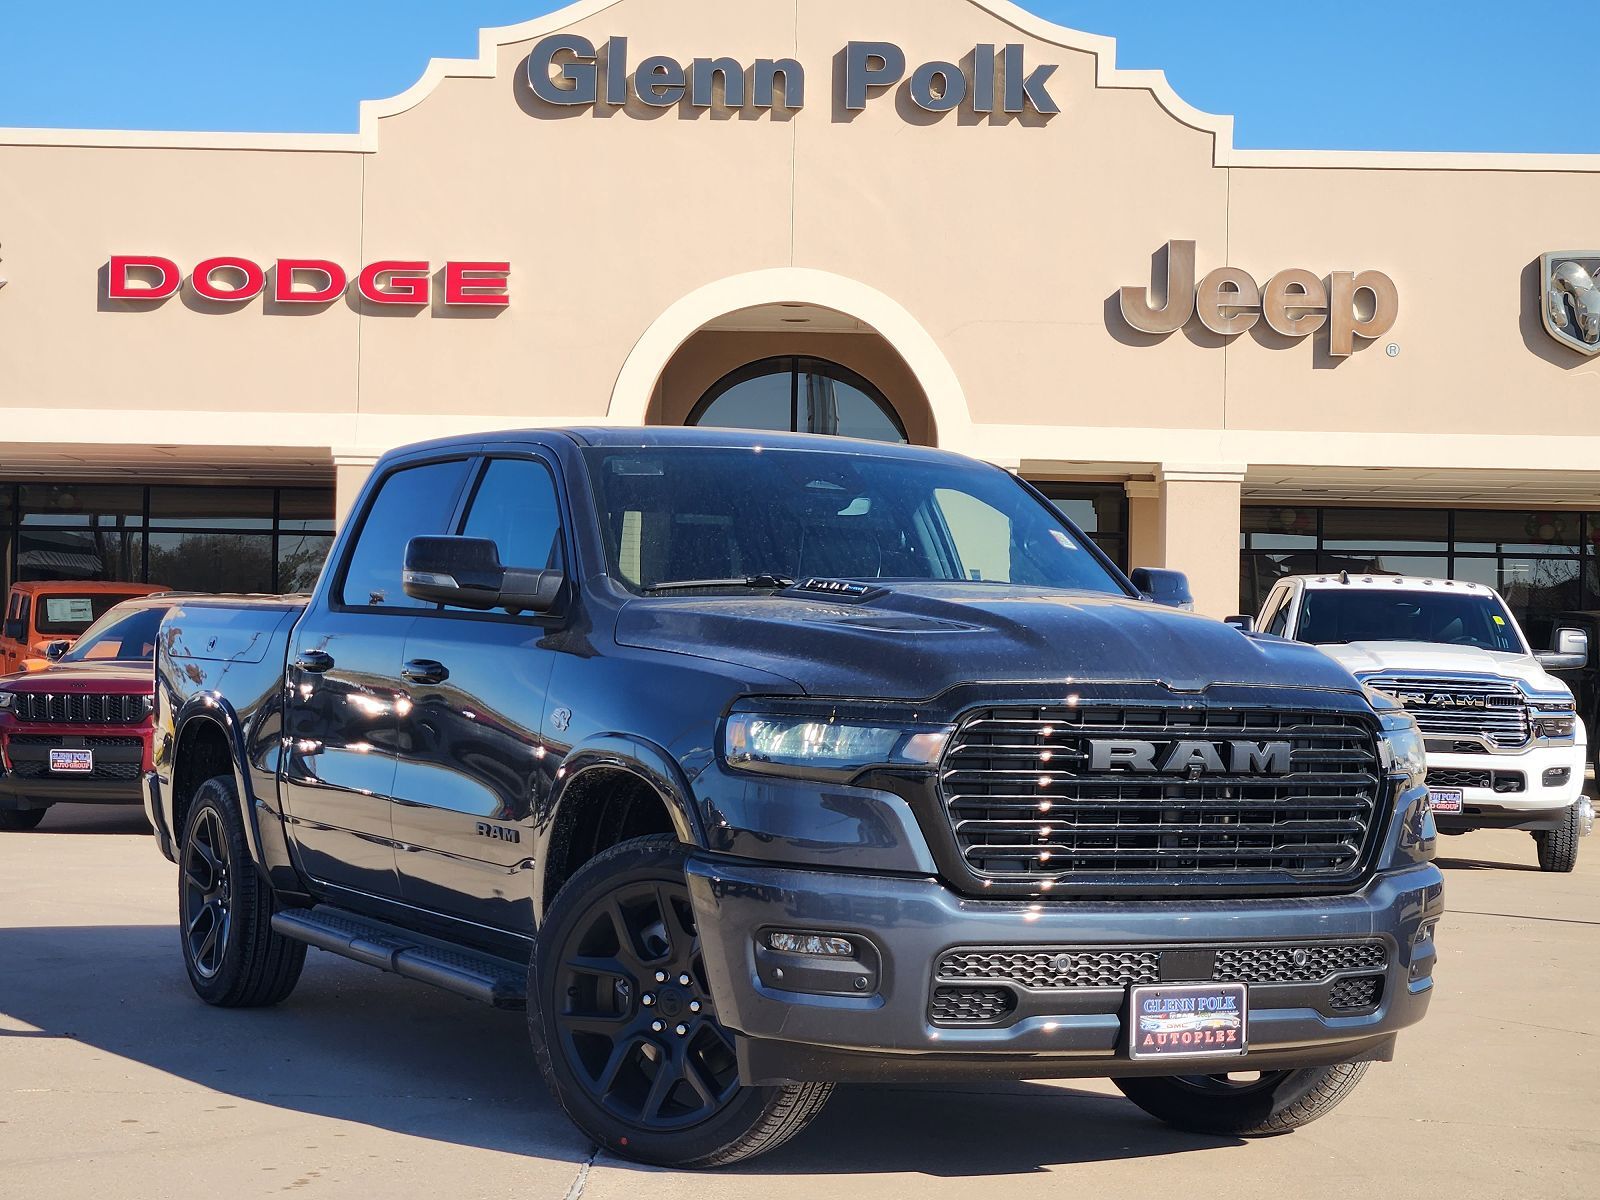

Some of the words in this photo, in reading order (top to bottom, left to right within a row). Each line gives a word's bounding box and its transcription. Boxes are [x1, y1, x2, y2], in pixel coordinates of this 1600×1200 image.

[527, 33, 804, 109] Glenn
[845, 40, 1061, 115] Polk
[108, 255, 511, 305] DODGE
[1119, 239, 1399, 356] Jeep
[1399, 691, 1485, 707] RAM
[1088, 738, 1291, 774] RAM
[476, 821, 520, 843] RAM
[1143, 998, 1196, 1012] GLENN
[1197, 996, 1236, 1010] POLK
[1143, 1030, 1236, 1045] AUTOPLEX
